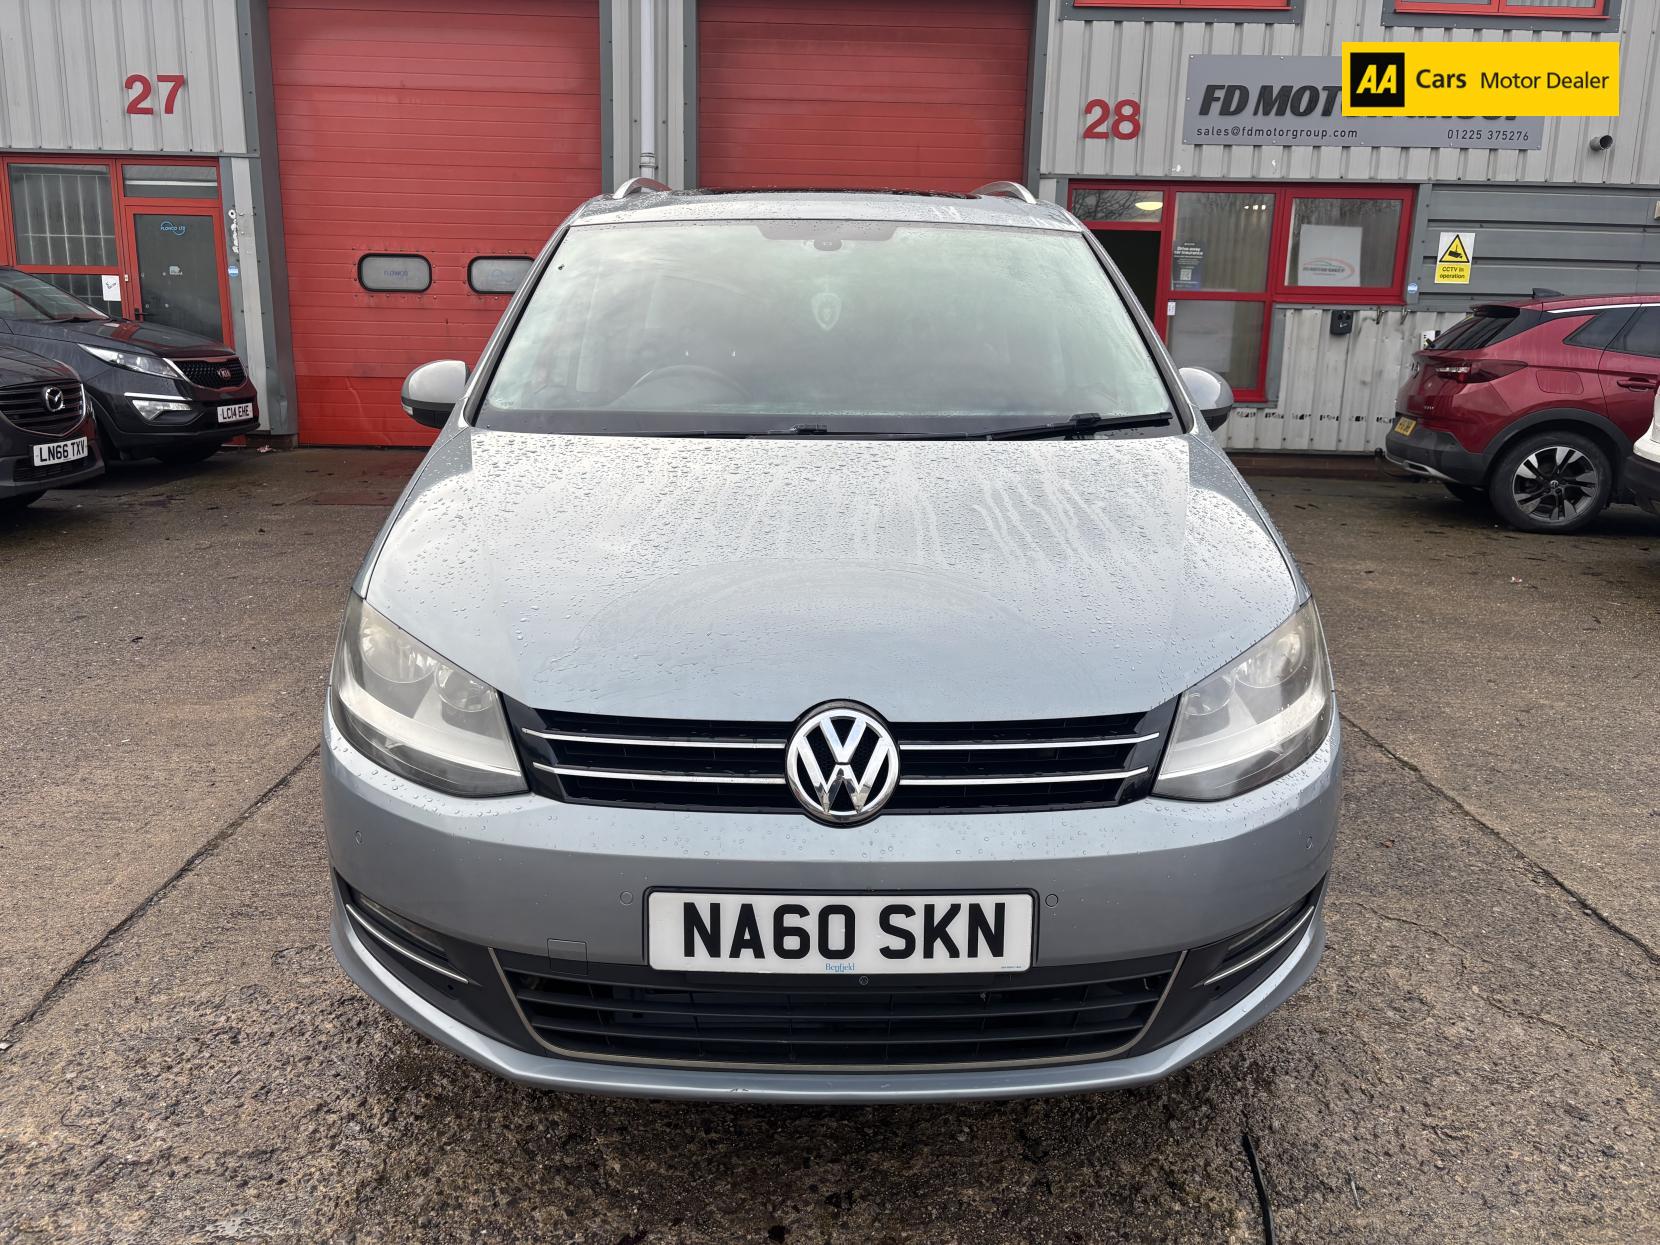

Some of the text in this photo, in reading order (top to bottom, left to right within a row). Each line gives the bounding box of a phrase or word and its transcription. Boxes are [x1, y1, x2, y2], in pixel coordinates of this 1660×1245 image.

[124, 74, 185, 115] 27
[1199, 84, 1343, 117] FD MOT
[1083, 98, 1141, 140] 28
[1196, 126, 1358, 140] sales@fdmotorgroup.com
[1447, 129, 1529, 141] 01225 375276
[222, 405, 250, 420] LC14 EHE
[40, 440, 85, 462] LN66 TXV
[683, 902, 1006, 960] NA60 SKN
